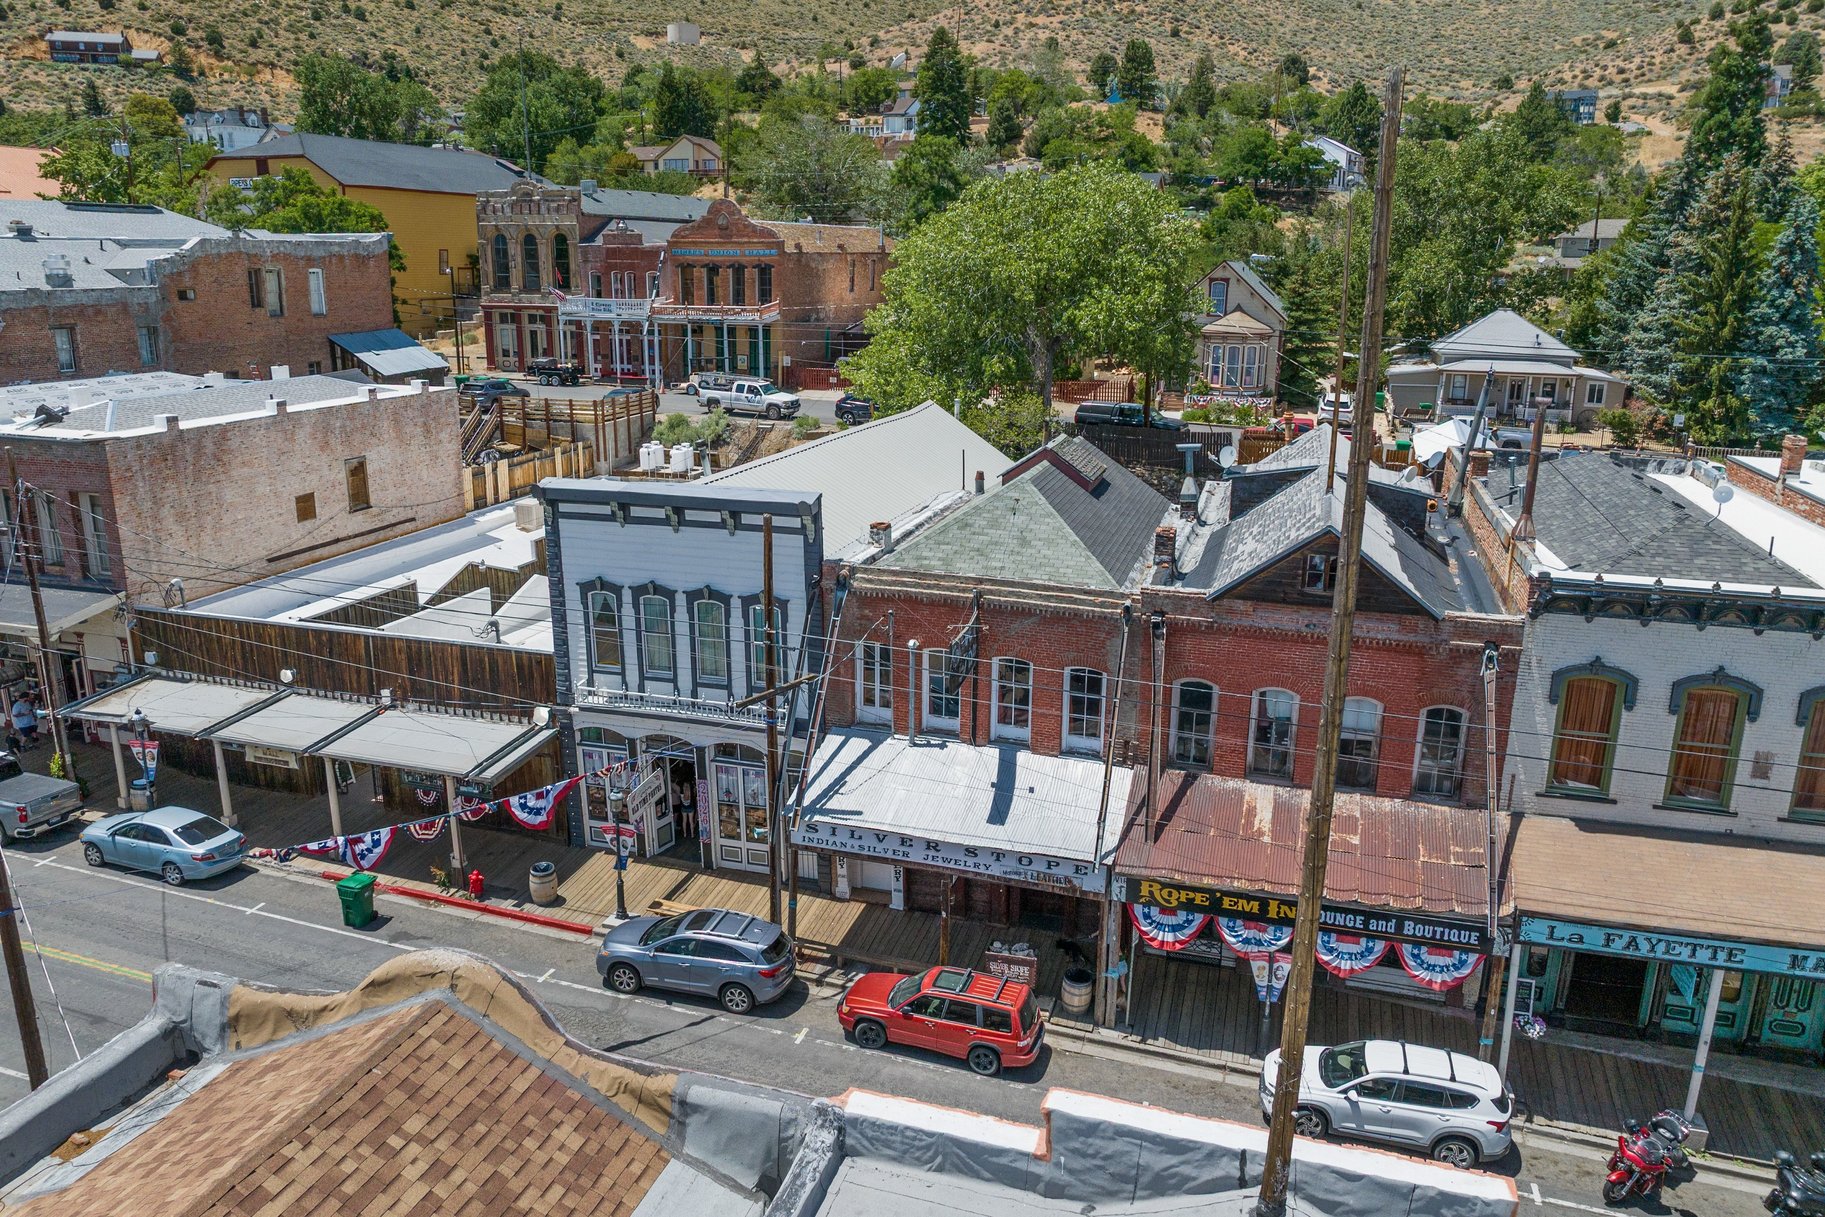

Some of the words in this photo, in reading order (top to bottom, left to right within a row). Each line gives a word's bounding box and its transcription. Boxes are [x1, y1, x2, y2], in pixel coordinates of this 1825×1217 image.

[802, 835, 848, 848] INDIAN
[857, 845, 910, 858] SILVER
[805, 823, 941, 852] SILVER
[964, 847, 1089, 876] STOPE
[1319, 910, 1365, 929] OUNGE
[1369, 919, 1397, 934] and
[1403, 920, 1480, 945] BOUTIQUE
[1545, 924, 1585, 945] La
[1601, 932, 1746, 965] FAYETTE
